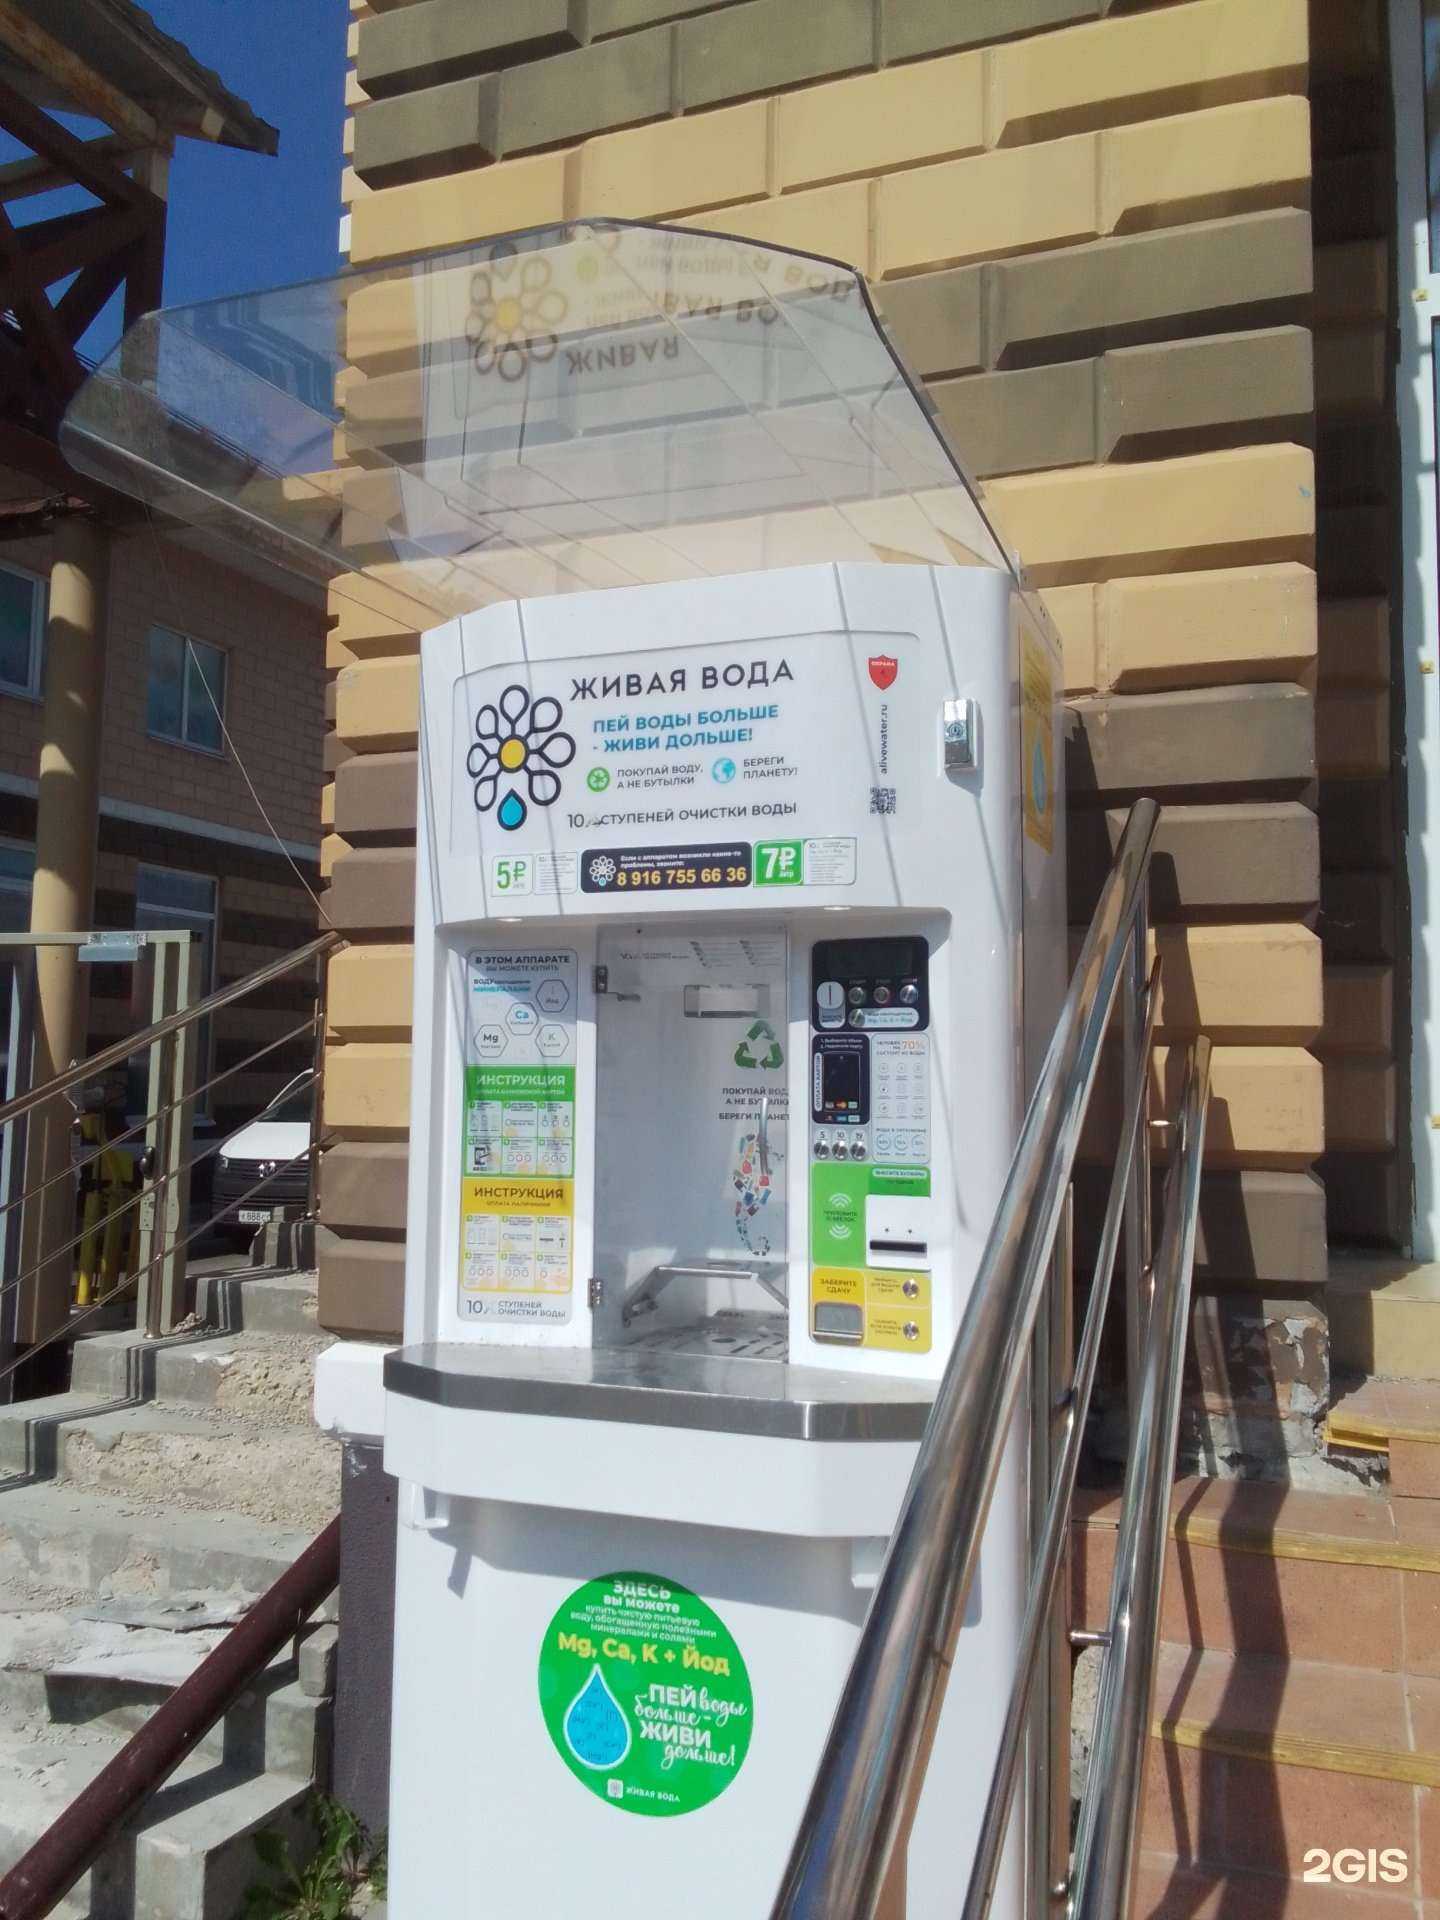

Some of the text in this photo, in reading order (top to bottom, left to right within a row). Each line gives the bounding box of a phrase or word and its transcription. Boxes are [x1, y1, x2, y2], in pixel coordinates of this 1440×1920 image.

[570, 658, 794, 701] ЖИВАЯ ВОДА
[593, 705, 779, 733] ПЕЙ ВОДЫ БОЛЬШЕ
[604, 736, 660, 752] ЖИВИ
[665, 728, 753, 750] ДОЛЬШЕ!
[878, 704, 888, 775] alivewater.ru
[743, 757, 784, 767] БЕРЕГИ
[617, 764, 704, 777] ПОКУПАЙ ВОДУ,
[743, 768, 798, 779] ПЛАНЕТУ!
[627, 780, 641, 788] НЕ
[644, 777, 695, 787] БУТЫЛКИ
[600, 810, 674, 825] СТУПЕНЕЙ
[679, 805, 747, 820] ОЧИСТКИ
[752, 802, 797, 816] ВОДЫ
[617, 866, 747, 886] 8 916 755 66 36
[515, 955, 570, 963] АППАРАТЕ
[483, 1034, 498, 1043] Mg
[477, 1074, 565, 1087] ИНСТРУКЦИЯ
[722, 1087, 766, 1095] ПОКУПАЙ
[474, 1187, 564, 1200] ИНСТРУКЦИЯ
[827, 1285, 852, 1294] СДАЧУ
[467, 1299, 483, 1314] 10
[613, 1580, 671, 1600] ЗДЕСЬ
[654, 1613, 700, 1626] питьевую
[591, 1624, 650, 1638] минералами
[662, 1621, 717, 1638] полезными
[558, 1632, 597, 1659] Mg,
[664, 1649, 676, 1662] +
[682, 1645, 731, 1676] Йод
[634, 1694, 701, 1725] больше
[650, 1683, 748, 1727] ПЕЙ воды
[639, 1720, 712, 1748] ЖИВИ
[626, 1786, 681, 1802] ЖИВАЯ ВОДА
